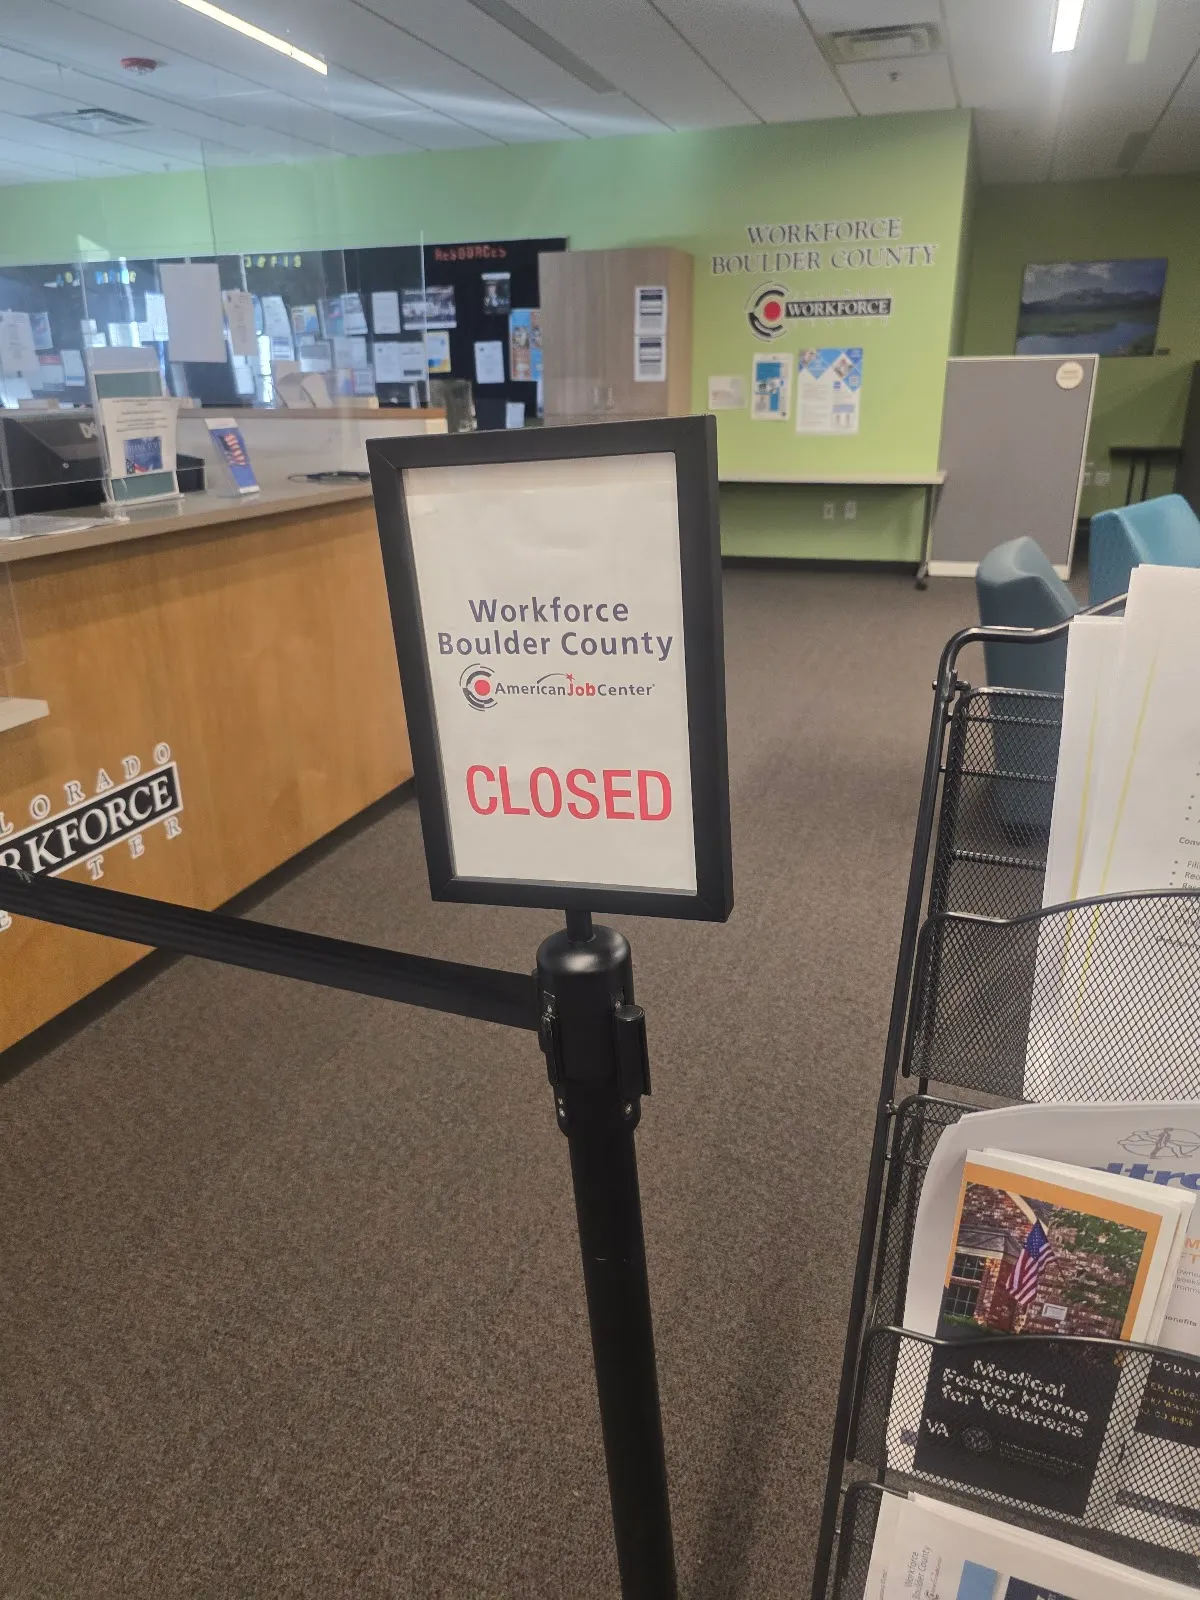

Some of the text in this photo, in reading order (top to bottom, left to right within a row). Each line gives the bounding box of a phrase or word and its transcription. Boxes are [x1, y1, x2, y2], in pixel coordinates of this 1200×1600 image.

[748, 218, 902, 244] WORKFORCE
[711, 244, 937, 275] BOULDER COUNTY
[787, 299, 890, 317] WORKFORCE
[468, 596, 630, 623] Workforce
[438, 630, 674, 662] Boulder County
[466, 764, 672, 821] CLOSED
[973, 1359, 1066, 1398] Medical
[942, 1367, 1089, 1423] Foster Home
[941, 1384, 975, 1405] for
[980, 1394, 1084, 1439] Veterans
[926, 1418, 949, 1438] VA
[904, 1551, 919, 1588] Workforce
